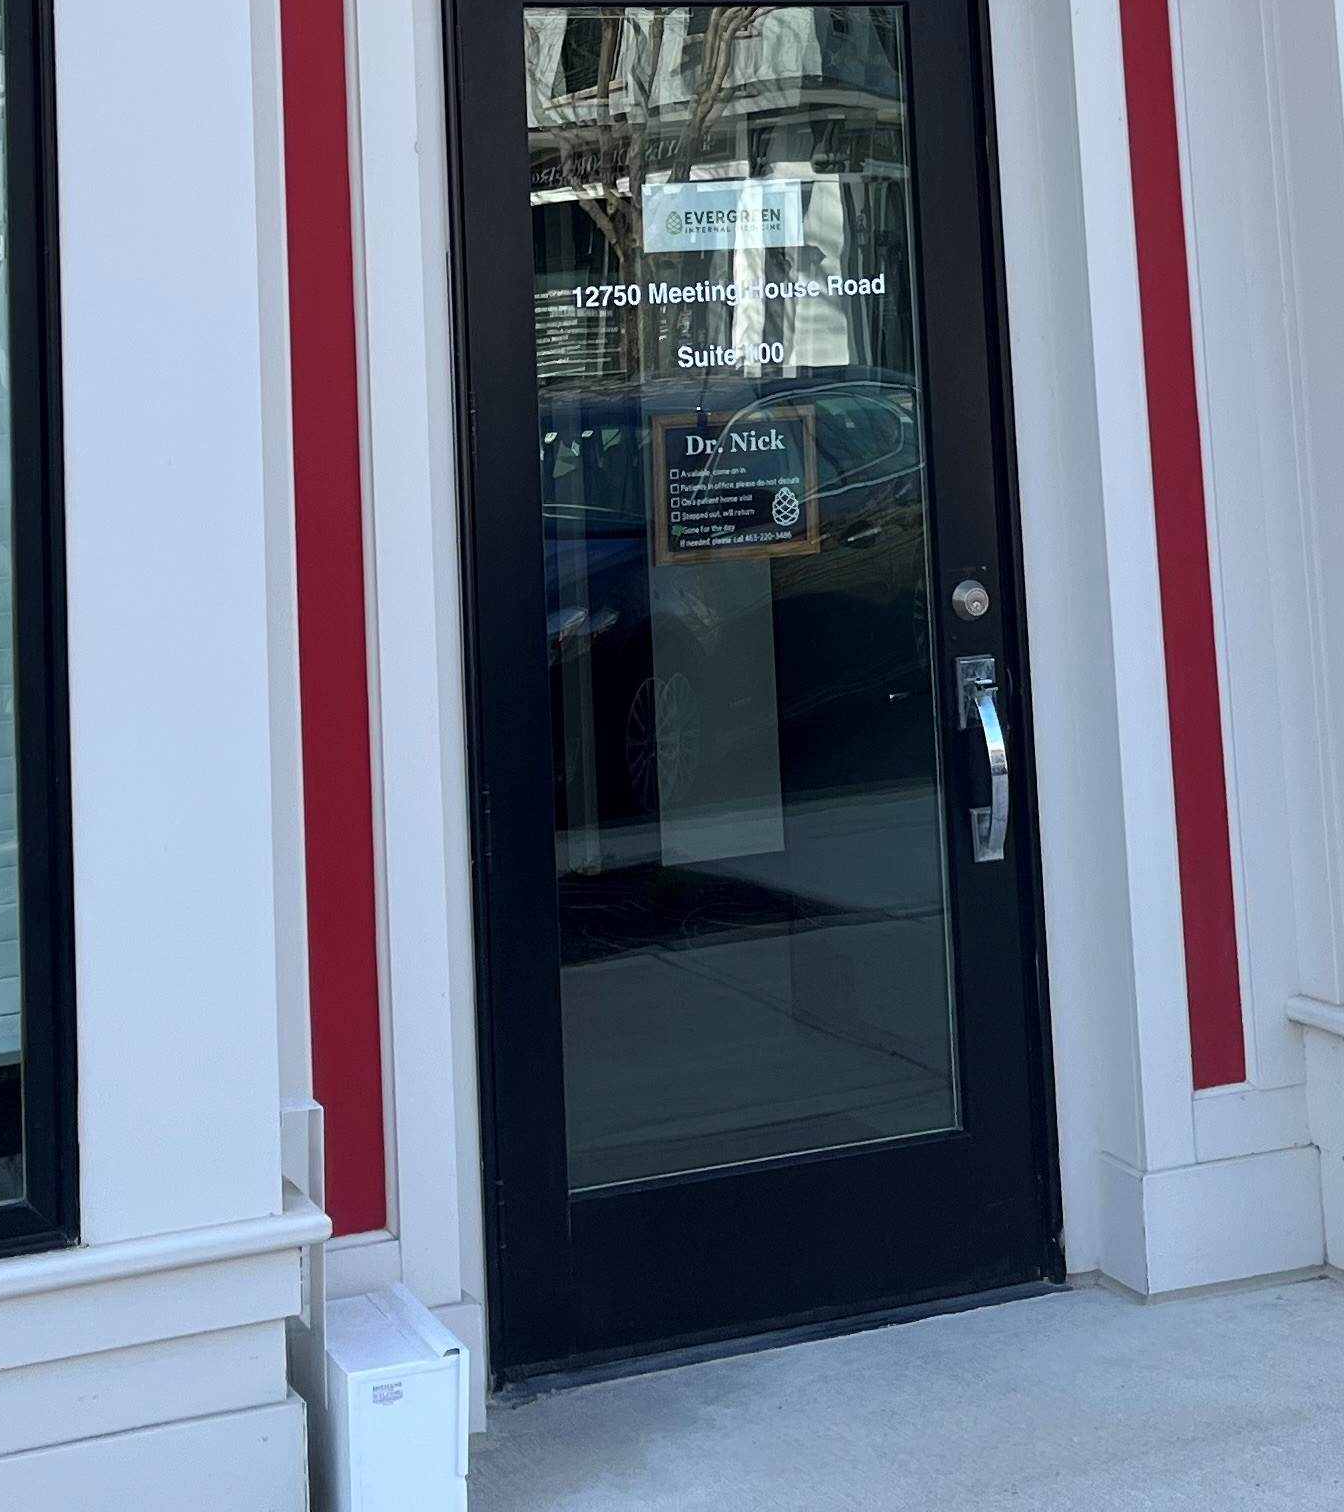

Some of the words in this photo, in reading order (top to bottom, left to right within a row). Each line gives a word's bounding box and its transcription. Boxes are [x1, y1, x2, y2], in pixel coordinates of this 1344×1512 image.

[685, 209, 781, 224] EVERGREEN
[572, 284, 642, 308] 12750
[648, 281, 739, 306] Meeting
[749, 278, 820, 301] House
[828, 274, 886, 296] Road
[677, 345, 735, 369] Suite
[685, 435, 723, 455] Dr.
[730, 429, 785, 452] Nick
